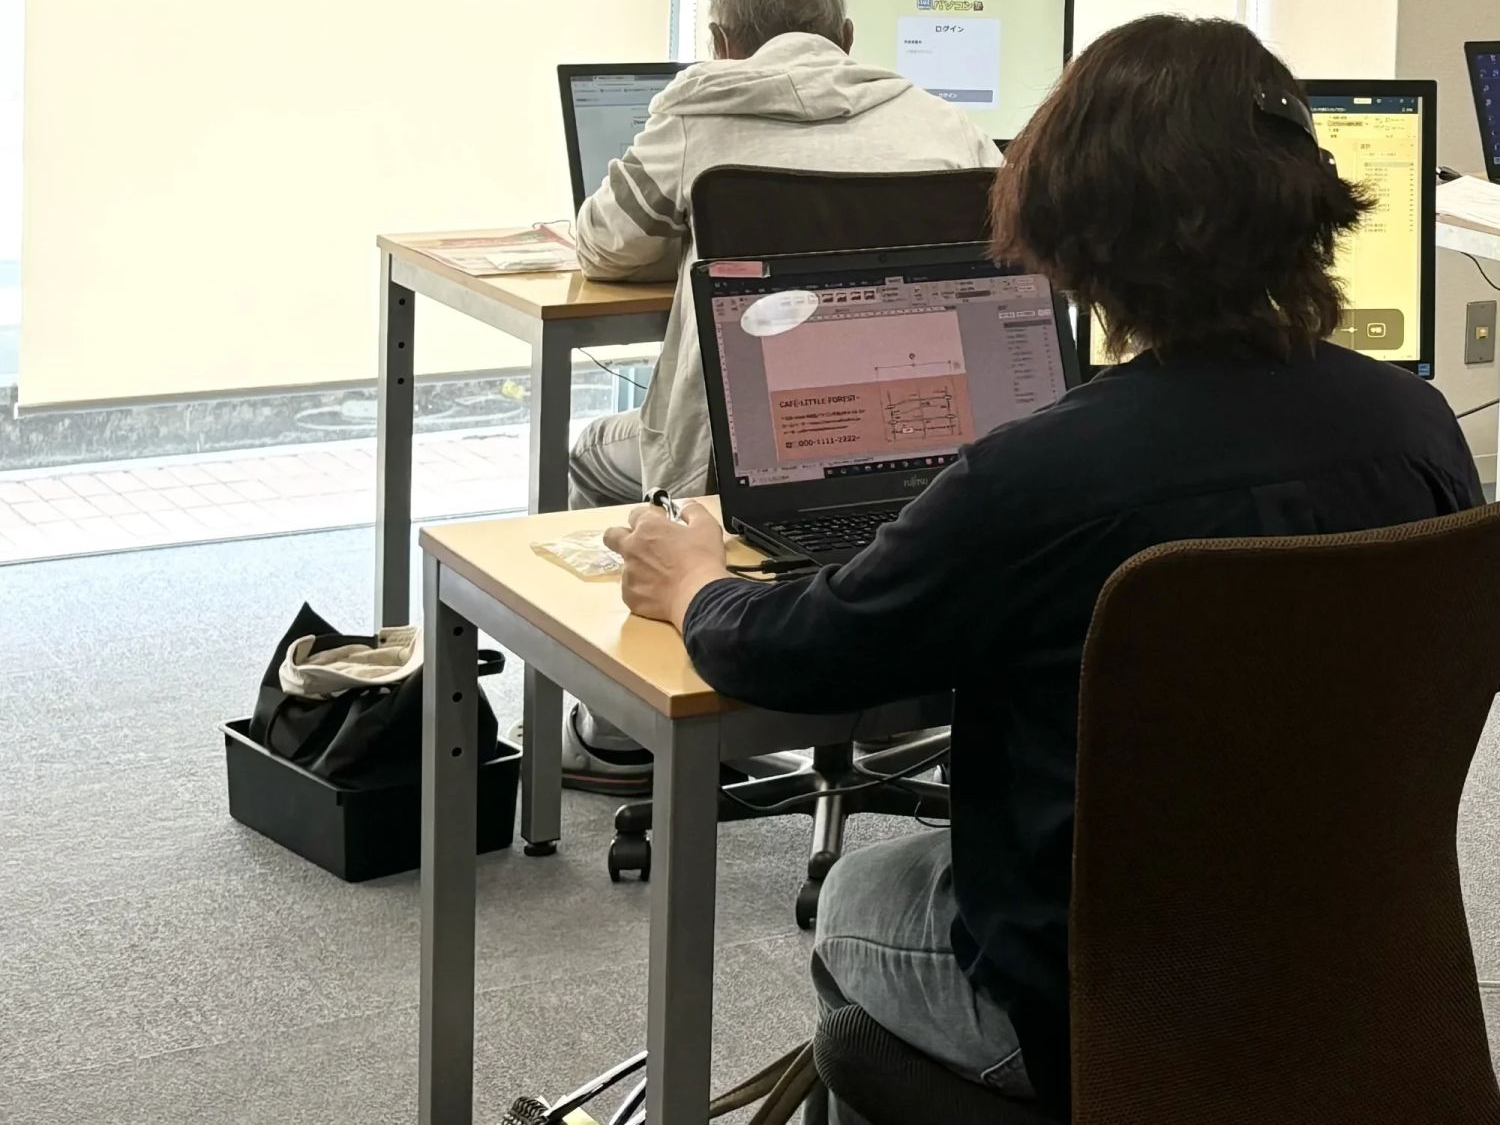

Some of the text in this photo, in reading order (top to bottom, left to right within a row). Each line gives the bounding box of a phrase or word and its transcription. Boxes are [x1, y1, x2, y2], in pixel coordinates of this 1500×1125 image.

[936, 25, 964, 33] ログイン
[801, 398, 826, 407] LITTLE
